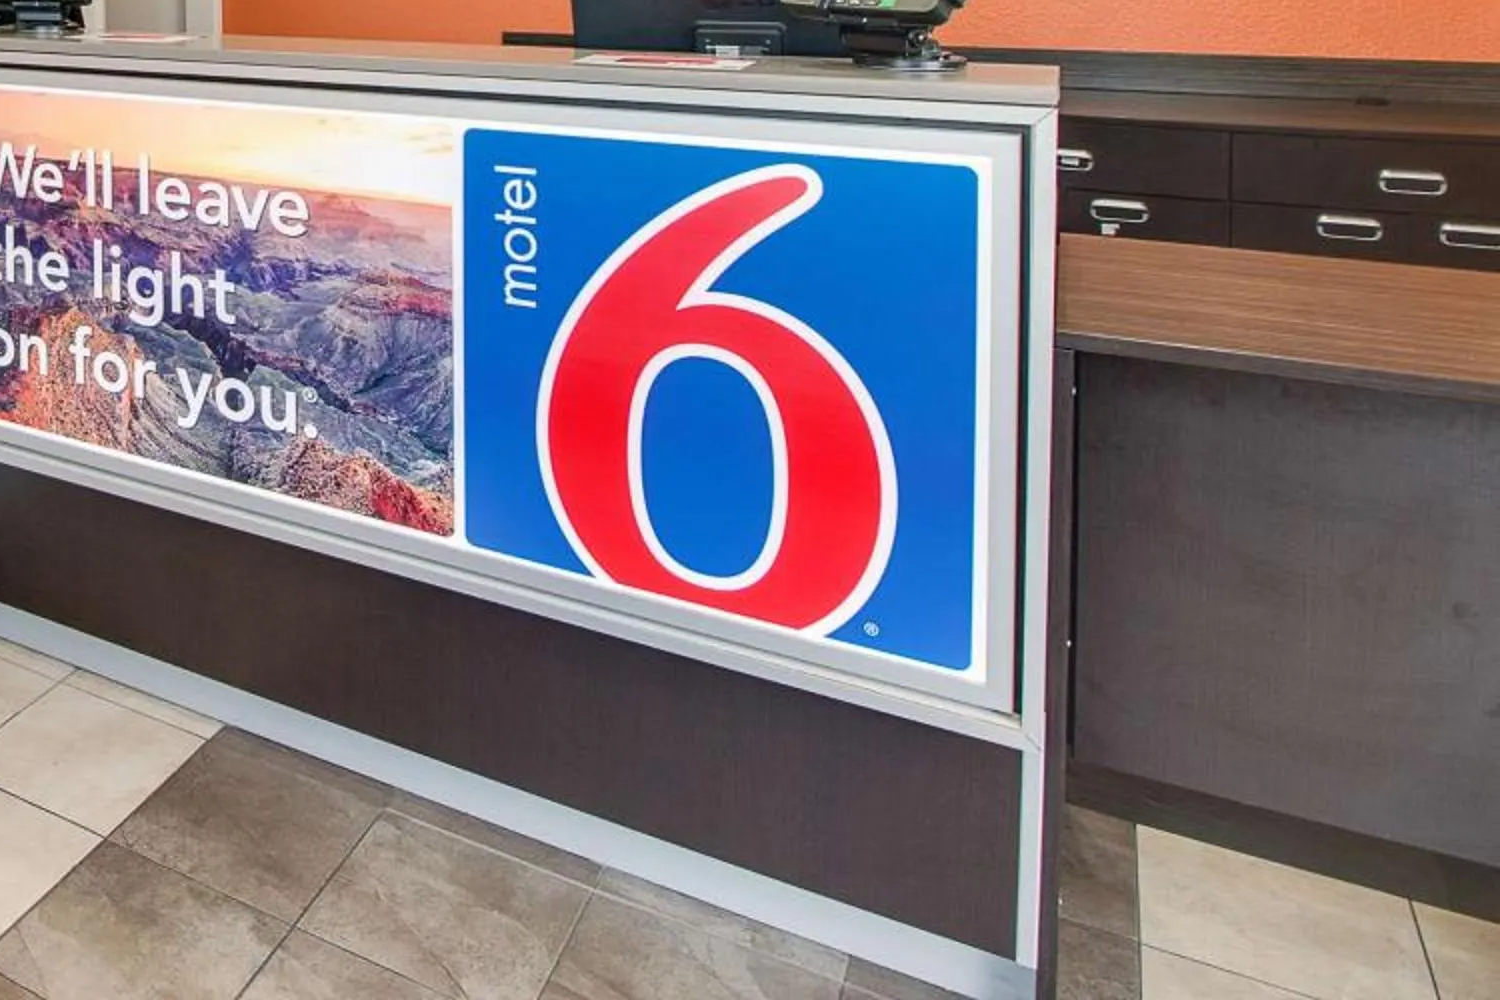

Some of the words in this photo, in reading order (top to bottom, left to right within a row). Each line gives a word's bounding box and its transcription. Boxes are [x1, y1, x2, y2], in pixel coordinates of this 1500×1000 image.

[139, 152, 311, 237] leave
[494, 164, 537, 309] motel
[93, 240, 237, 327] light
[68, 326, 156, 401] for
[535, 162, 899, 638] 6
